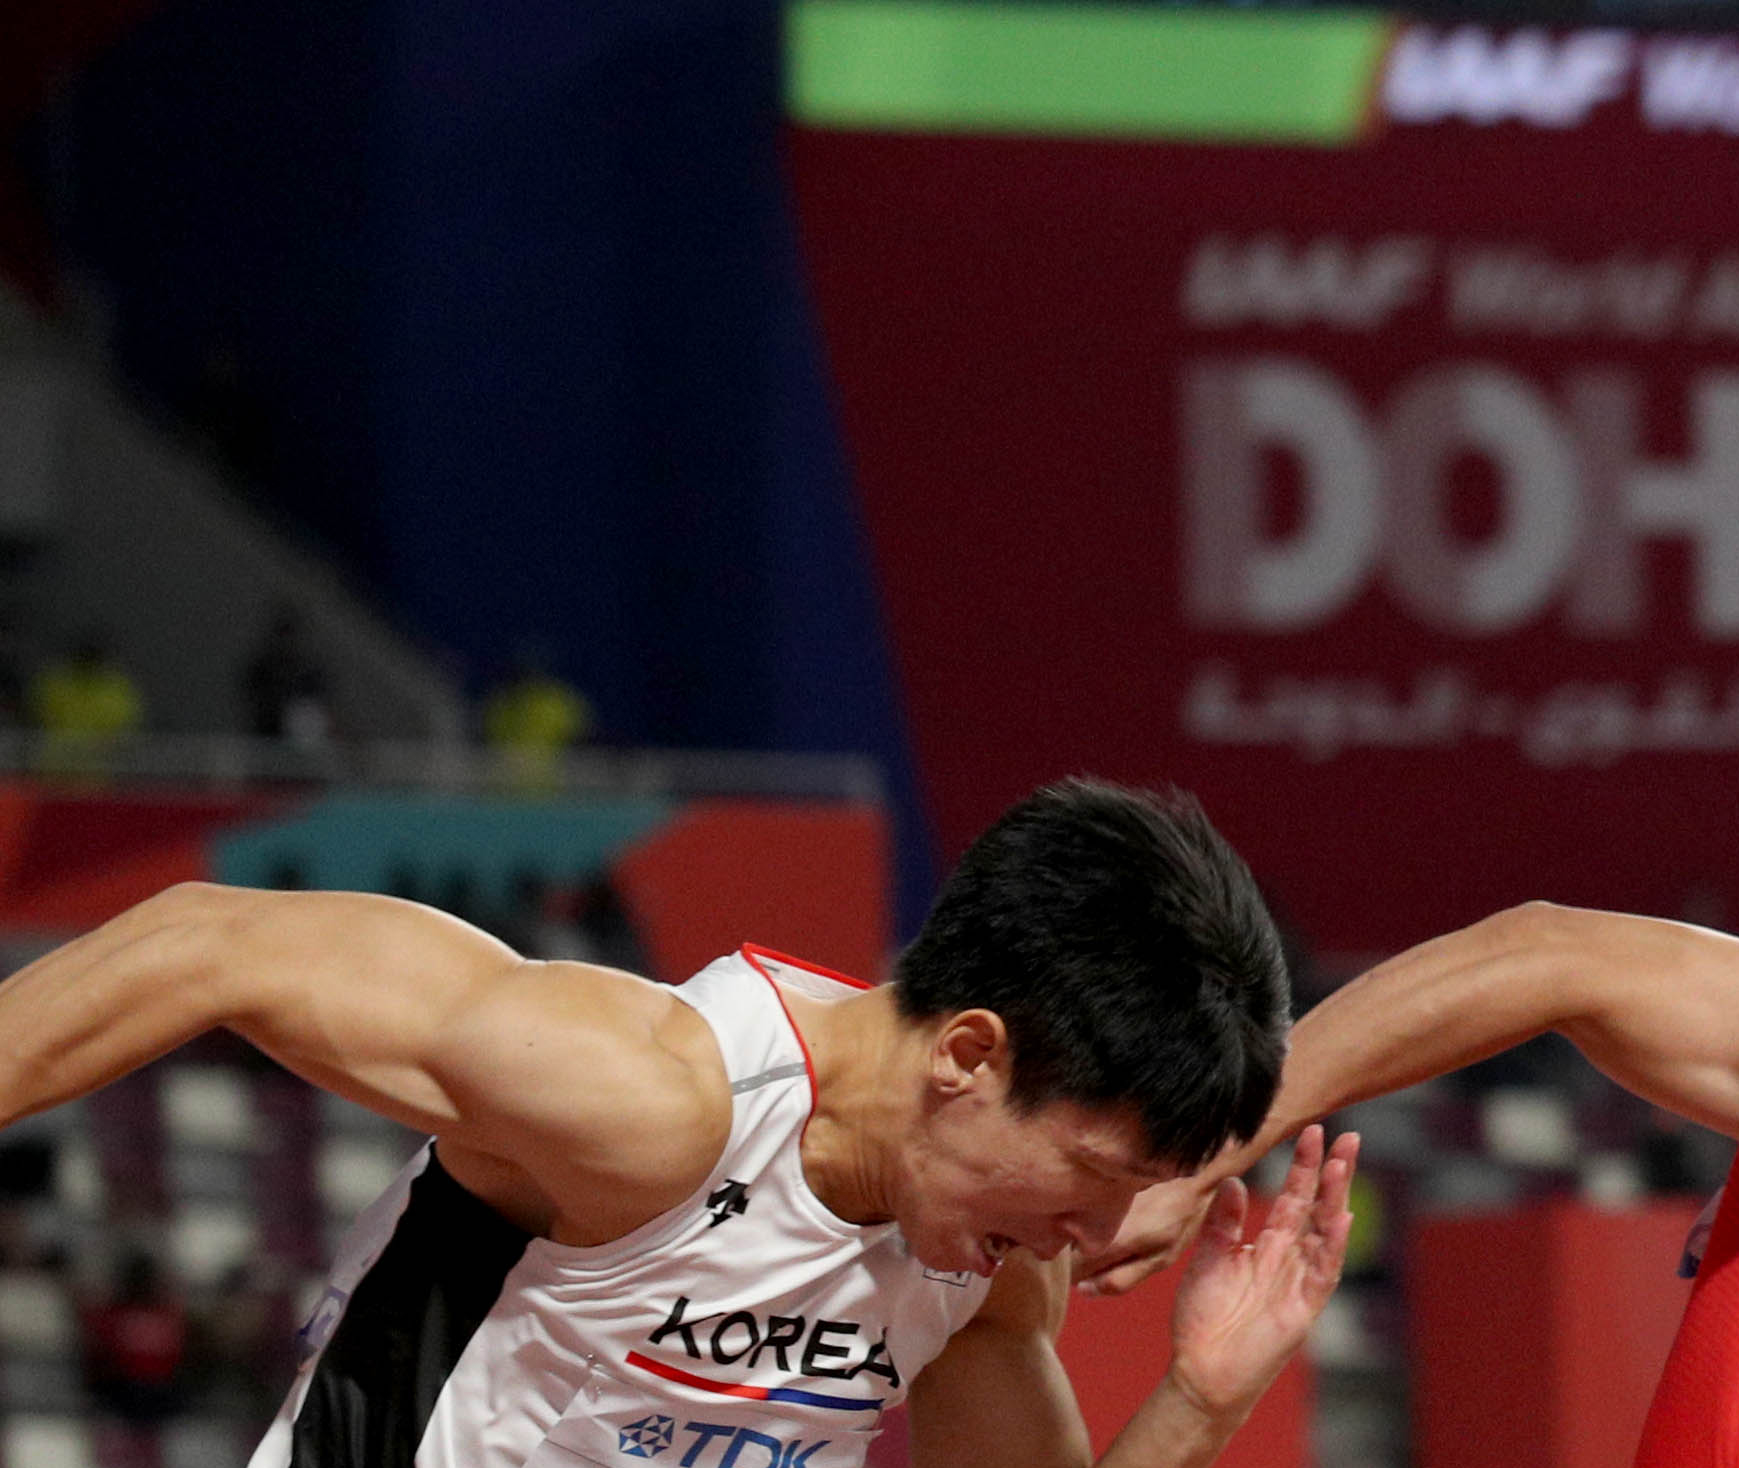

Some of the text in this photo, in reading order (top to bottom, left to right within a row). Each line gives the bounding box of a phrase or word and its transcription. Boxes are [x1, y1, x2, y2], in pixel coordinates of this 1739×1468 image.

[1383, 26, 1632, 128] IAAF
[1184, 236, 1432, 330] IAAF
[1443, 242, 1692, 340] World
[648, 1296, 901, 1389] KOREA
